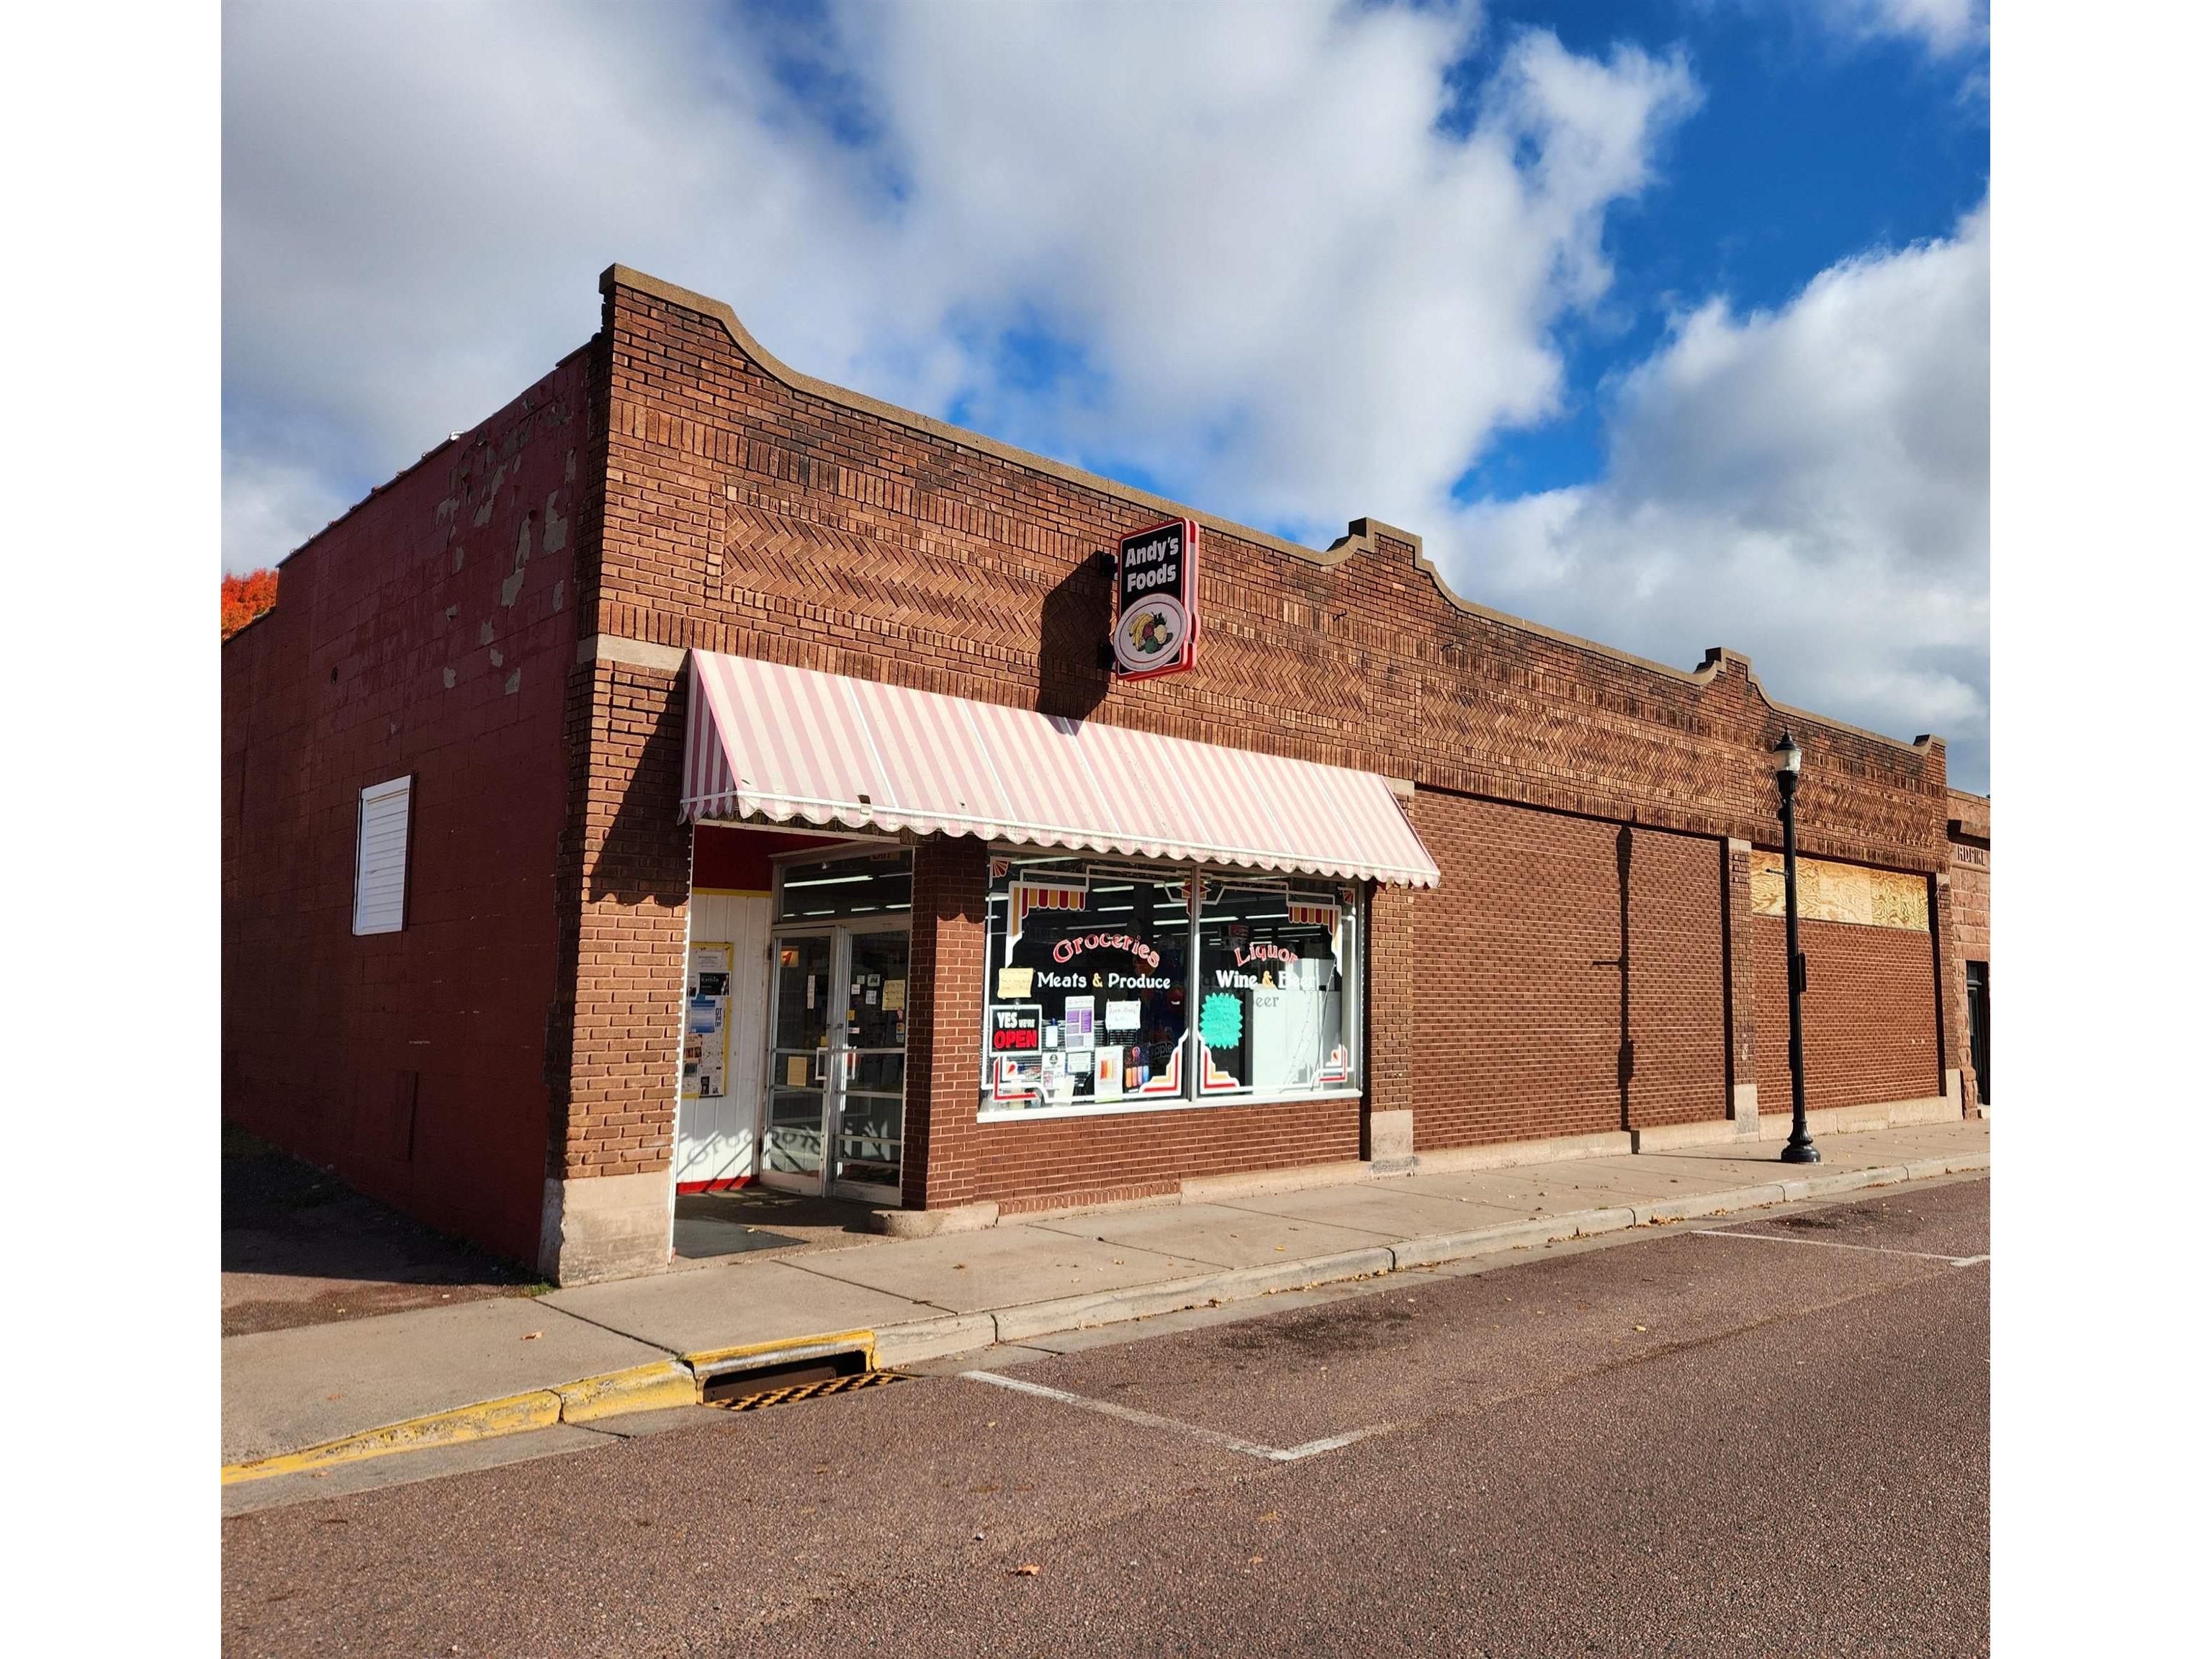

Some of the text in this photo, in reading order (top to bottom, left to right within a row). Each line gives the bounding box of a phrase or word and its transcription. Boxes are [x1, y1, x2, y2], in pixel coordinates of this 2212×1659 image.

[1125, 536, 1179, 567] Andy's
[1127, 563, 1177, 592] Foods
[1053, 933, 1160, 968] Groceries
[1233, 943, 1299, 967] Liquor
[1038, 972, 1087, 989] Meats
[1092, 973, 1103, 988] &
[1107, 972, 1171, 989] Produce
[1215, 970, 1316, 990] Wine & Beer
[997, 1012, 1017, 1028] YES
[994, 1030, 1038, 1049] OPEN
